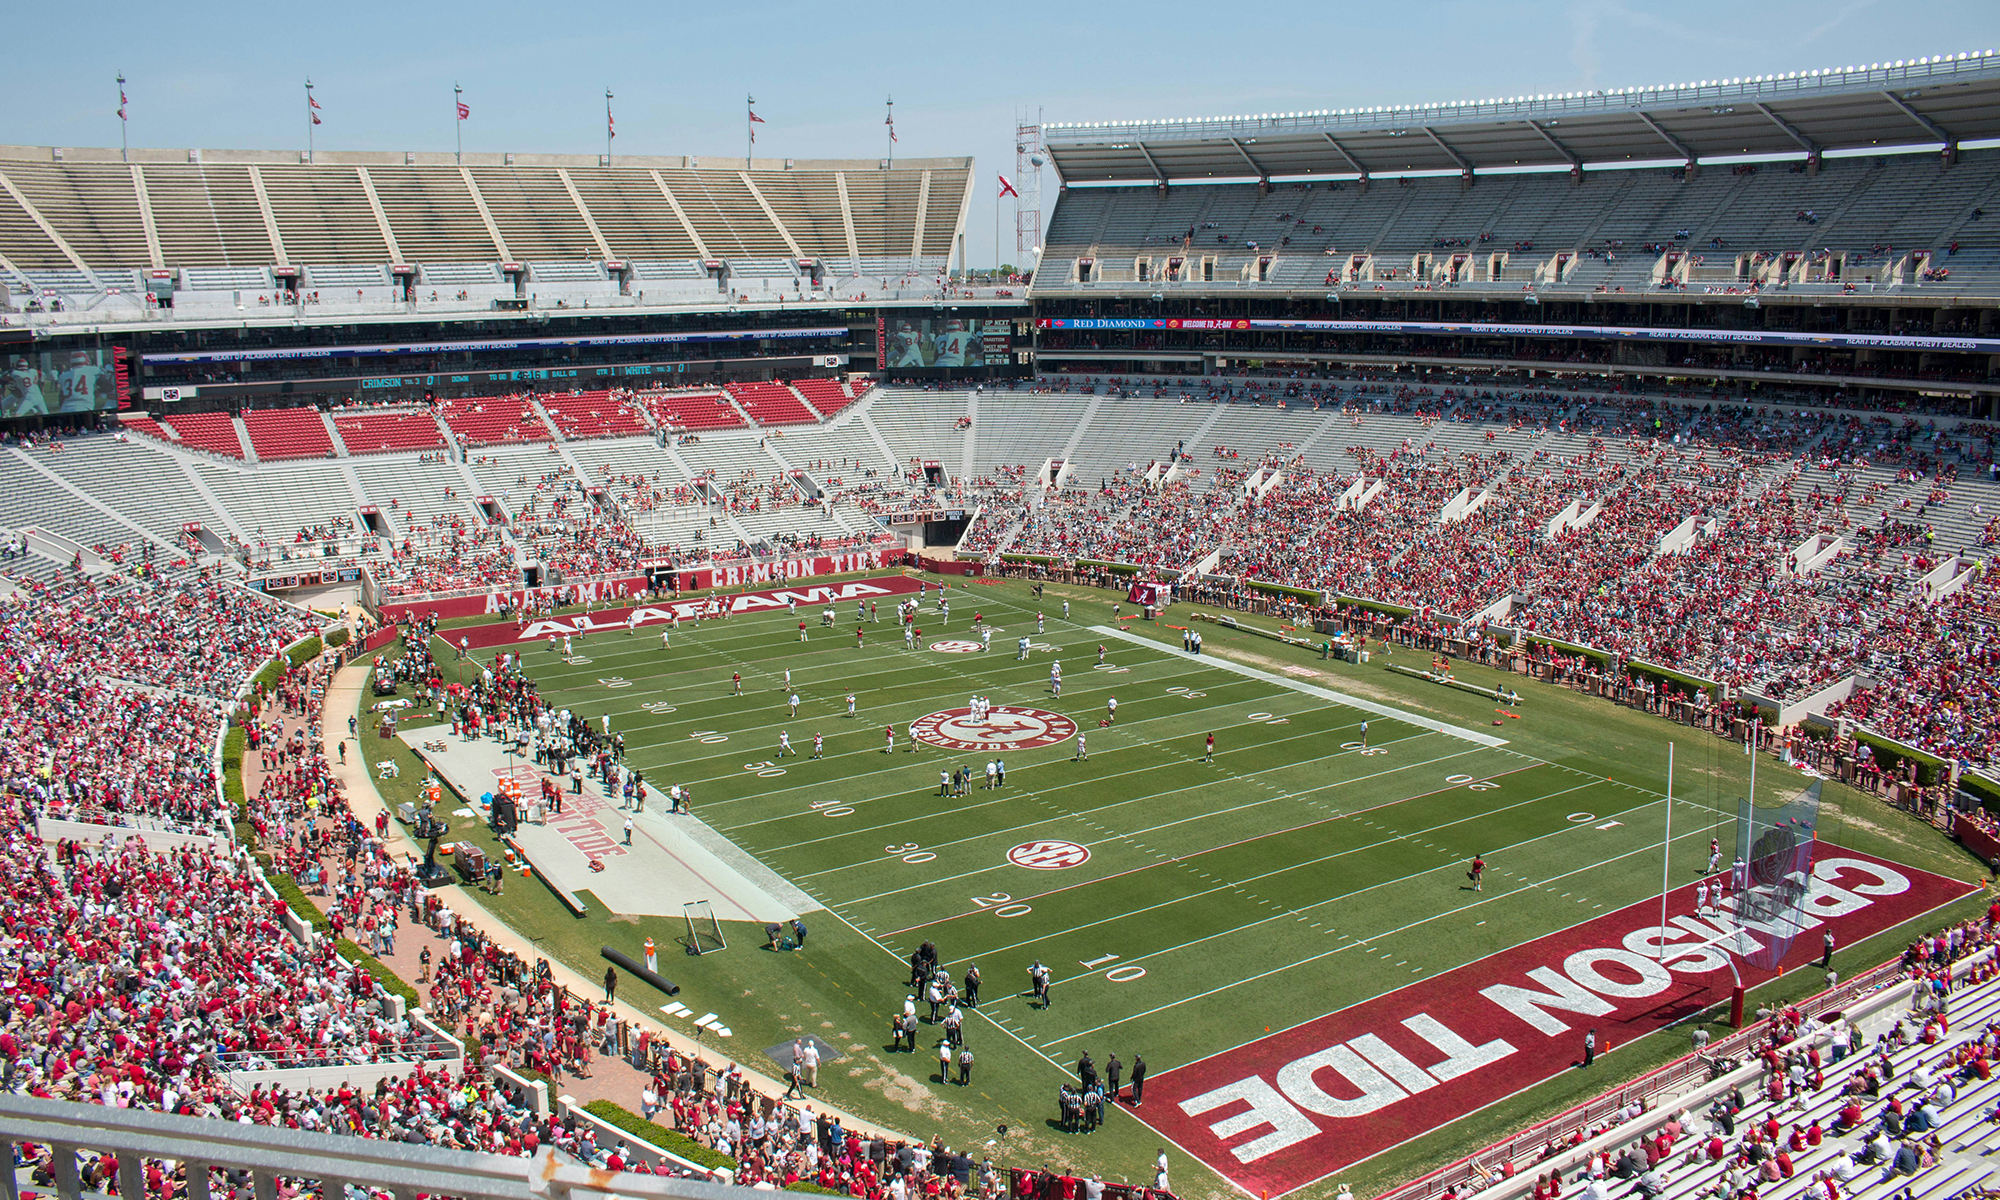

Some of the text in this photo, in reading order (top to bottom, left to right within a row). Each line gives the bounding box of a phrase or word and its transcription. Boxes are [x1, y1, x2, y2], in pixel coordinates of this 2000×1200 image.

[938, 338, 960, 356] 34
[625, 365, 652, 375] WHITE
[678, 364, 684, 372] 0
[112, 346, 131, 410] ALABAMA
[362, 378, 401, 389] CRIMSON
[426, 376, 434, 386] 0
[63, 375, 89, 399] 34
[323, 572, 336, 581] 25
[597, 676, 633, 688] 20
[641, 701, 677, 715] 30
[689, 731, 729, 744] 40
[743, 760, 787, 778] 50
[1444, 774, 1502, 791] 20
[809, 800, 855, 817] 40
[1565, 812, 1625, 831] 10
[884, 842, 937, 864] 30
[970, 892, 1032, 918] 20
[1078, 952, 1148, 982] 10
[1178, 1013, 1518, 1164] TIDE
